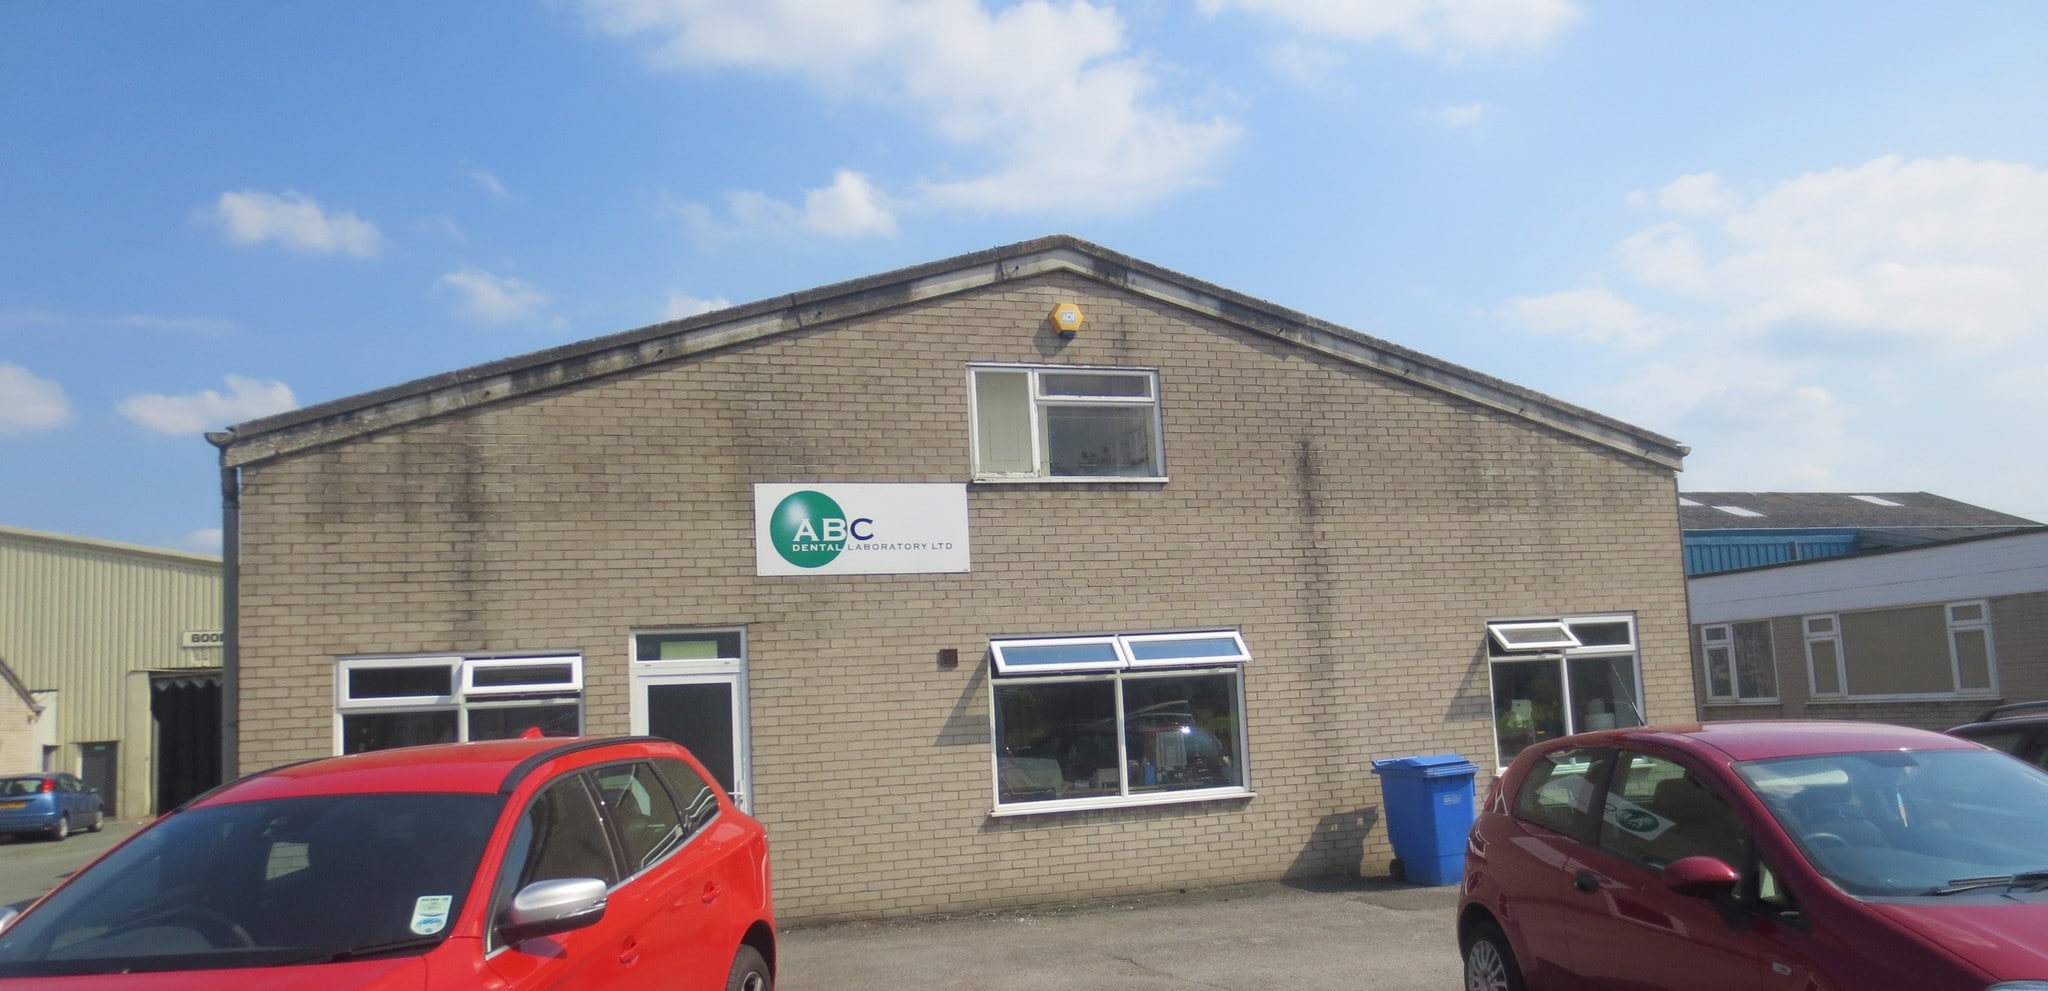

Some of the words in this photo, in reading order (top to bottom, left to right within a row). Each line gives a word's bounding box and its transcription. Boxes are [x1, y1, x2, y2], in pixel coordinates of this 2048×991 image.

[792, 518, 874, 541] ABC
[792, 543, 843, 552] DENTAL
[847, 543, 927, 551] LABORATORY
[931, 542, 953, 550] LTD
[192, 633, 223, 642] GOO
